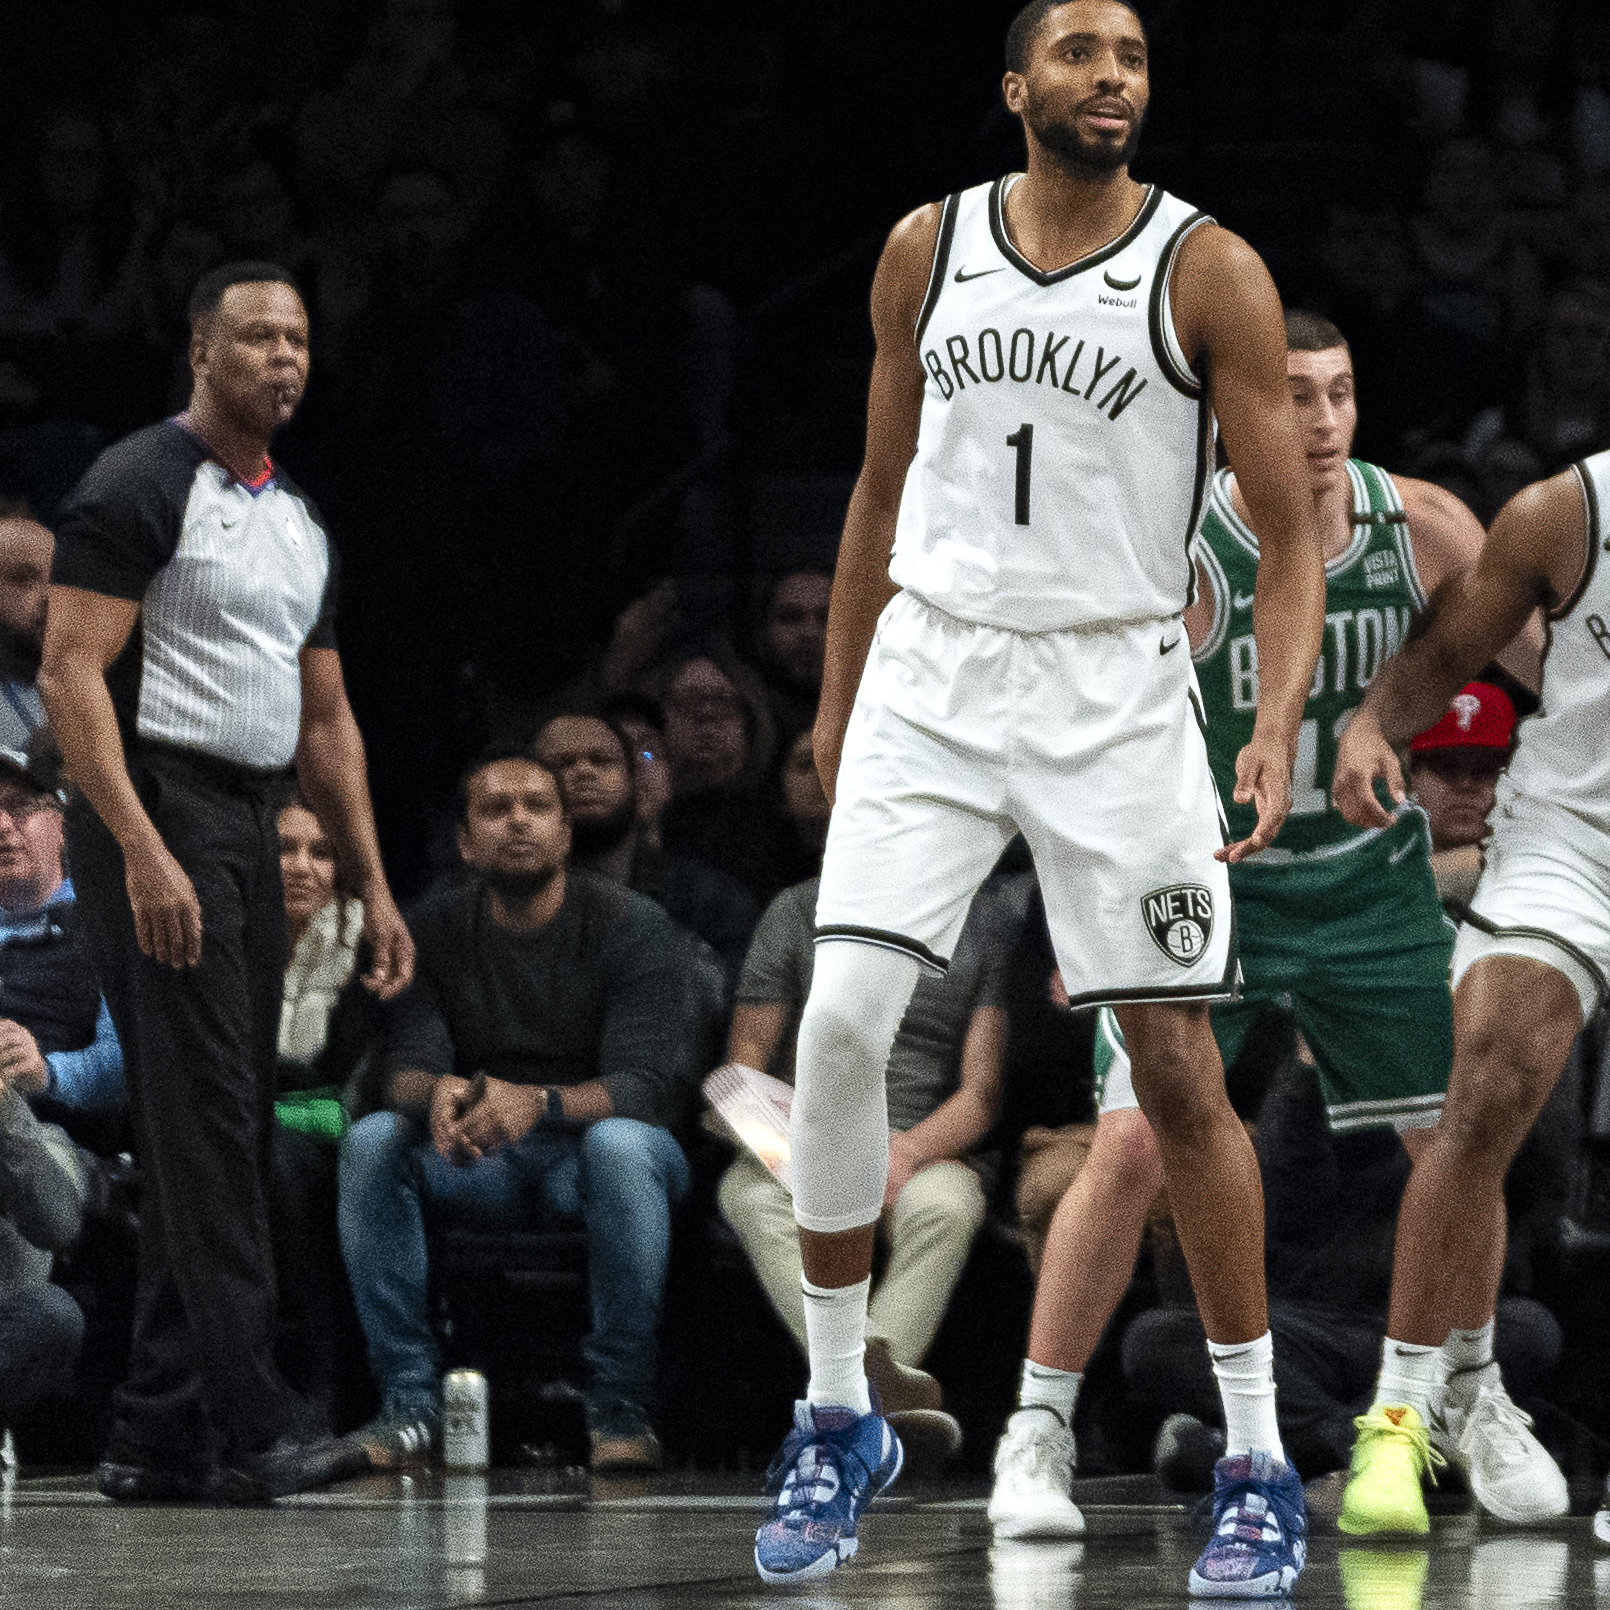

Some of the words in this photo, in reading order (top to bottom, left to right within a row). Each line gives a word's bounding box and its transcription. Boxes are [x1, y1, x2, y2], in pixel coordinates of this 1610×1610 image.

[1098, 294, 1138, 309] Webull
[924, 327, 1149, 421] BROOKLYN
[1006, 422, 1034, 526] 1
[1148, 888, 1212, 928] NETS
